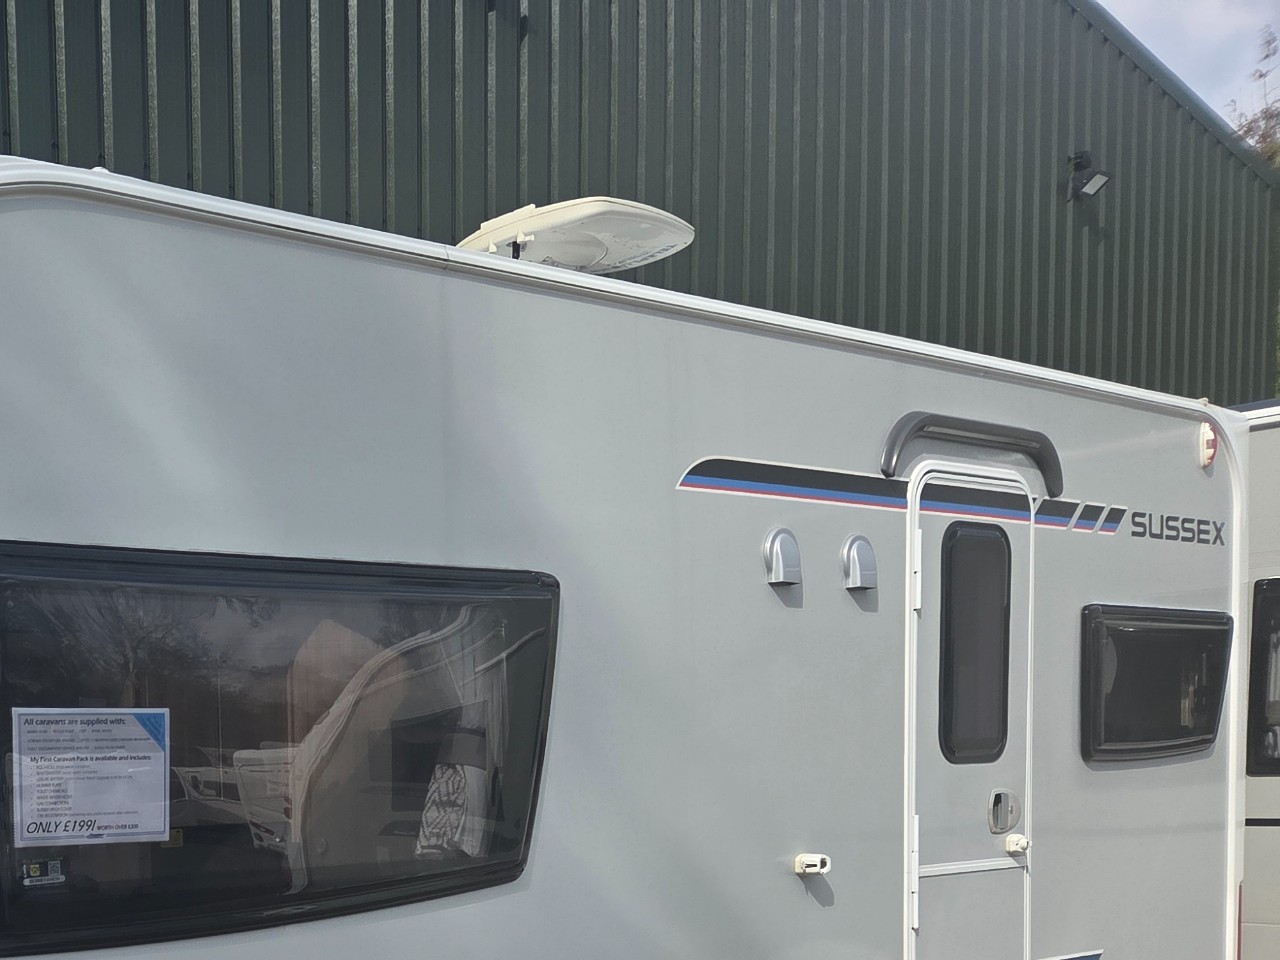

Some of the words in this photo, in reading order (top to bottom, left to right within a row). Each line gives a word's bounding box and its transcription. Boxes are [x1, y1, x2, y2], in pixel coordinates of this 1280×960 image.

[1131, 511, 1225, 547] SUSSEX
[24, 718, 34, 726] All
[80, 717, 108, 727] supplied
[26, 821, 62, 834] ONLY
